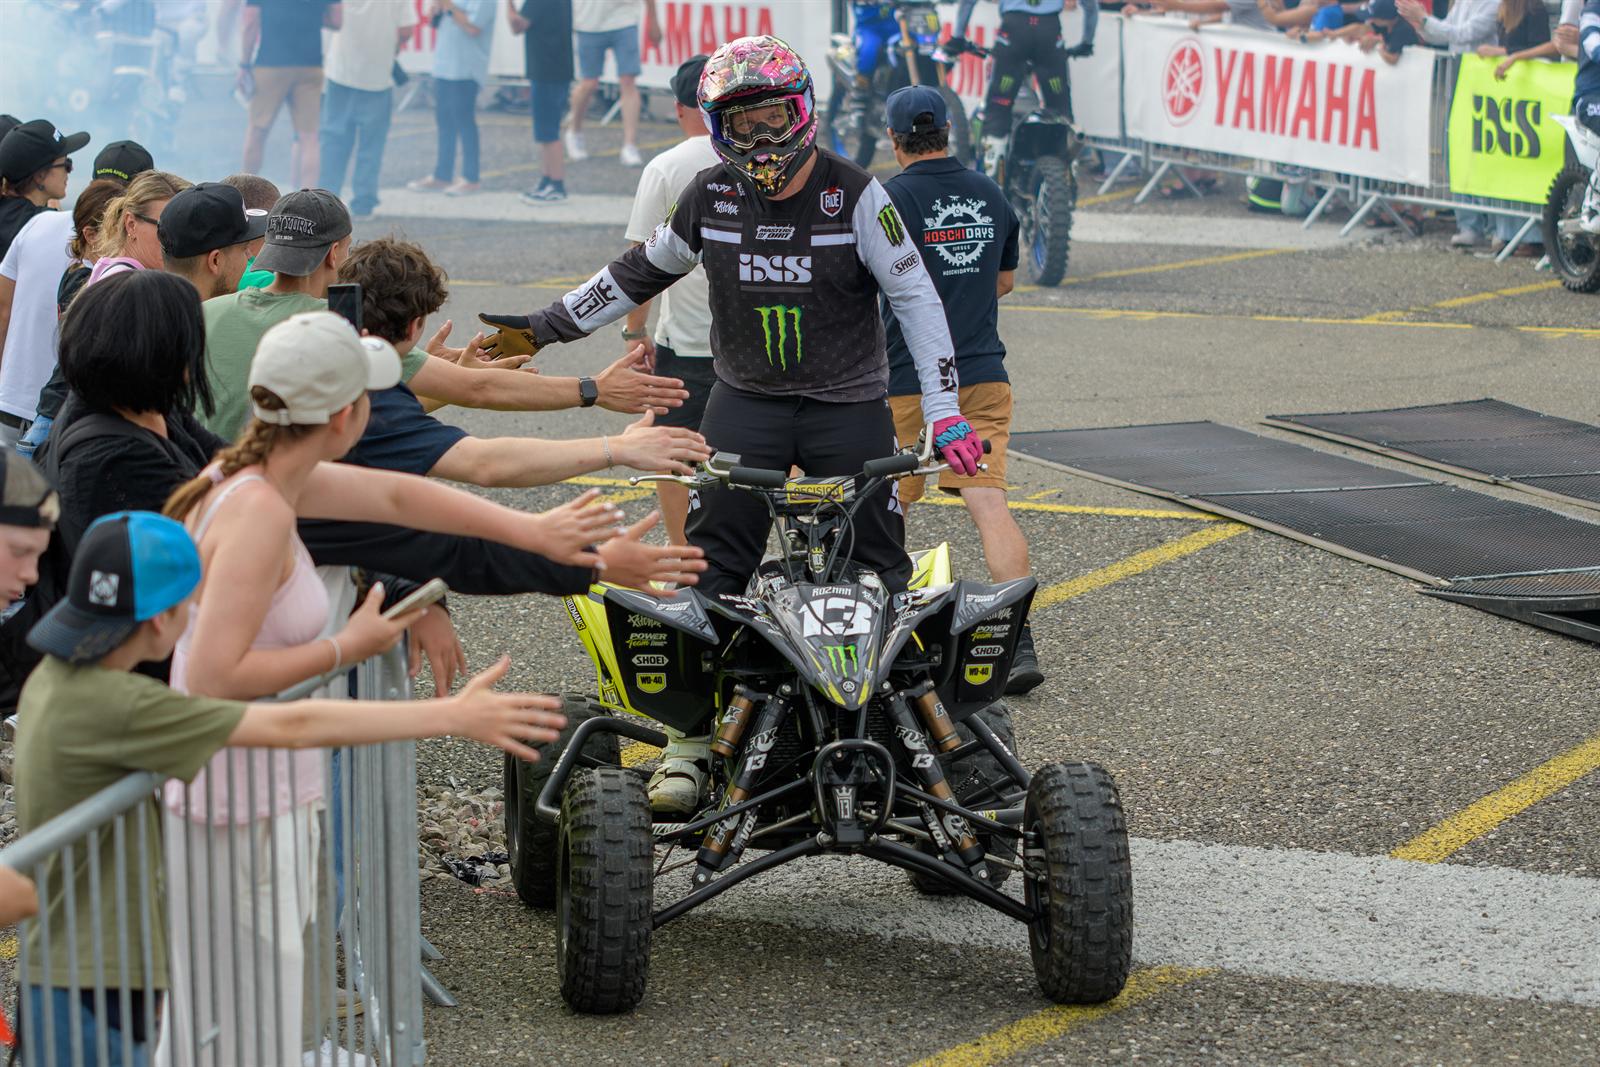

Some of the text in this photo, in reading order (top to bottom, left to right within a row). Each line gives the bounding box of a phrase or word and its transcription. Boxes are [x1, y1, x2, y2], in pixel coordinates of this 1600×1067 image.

[641, 2, 773, 65] AMAHA
[1213, 47, 1379, 152] YAMAHA
[825, 193, 839, 208] RIDE
[285, 215, 316, 235] YORK
[924, 228, 994, 243] HOSCHIDAYS
[812, 587, 852, 597] ROZMAN
[799, 597, 872, 638] 13
[976, 624, 1011, 632] POWER
[626, 639, 650, 649] Team
[974, 646, 1001, 655] SHOEI
[636, 655, 665, 665] SHOEI
[969, 667, 989, 676] WD-40
[640, 675, 663, 684] WD-40
[745, 753, 767, 772] 13
[912, 753, 935, 768] 13
